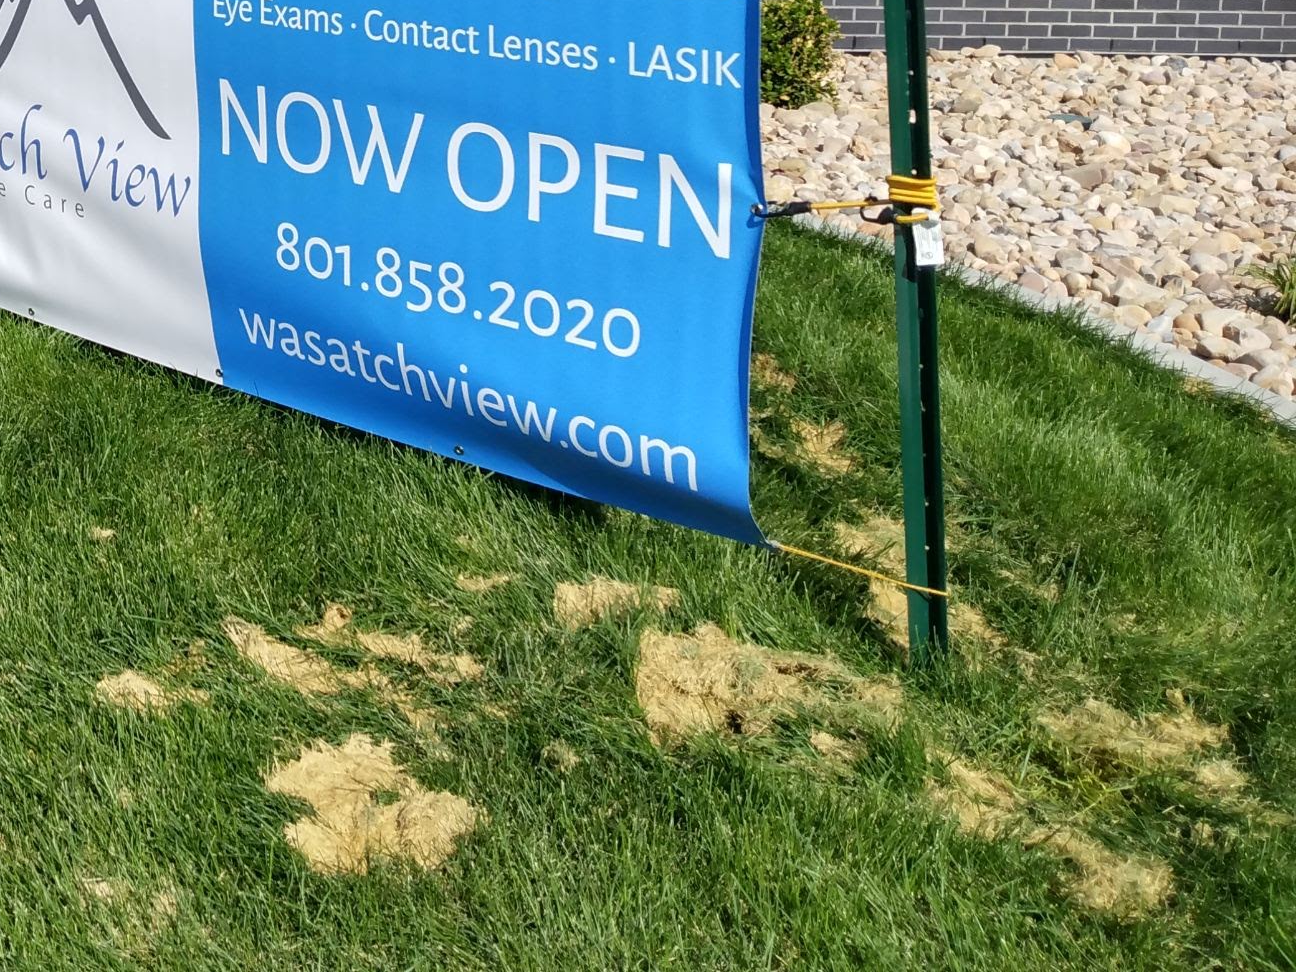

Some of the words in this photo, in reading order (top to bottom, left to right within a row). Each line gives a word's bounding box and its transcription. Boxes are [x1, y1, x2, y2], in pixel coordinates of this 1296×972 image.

[364, 10, 479, 55] Contact
[488, 25, 599, 71] Lenses
[628, 41, 742, 89] LASIK
[24, 185, 85, 218] Care
[62, 128, 191, 217] View
[219, 78, 424, 194] NOW
[446, 121, 732, 259] OPEN
[275, 222, 640, 357] 801.858.2020
[238, 307, 700, 492] wasatchview.com
